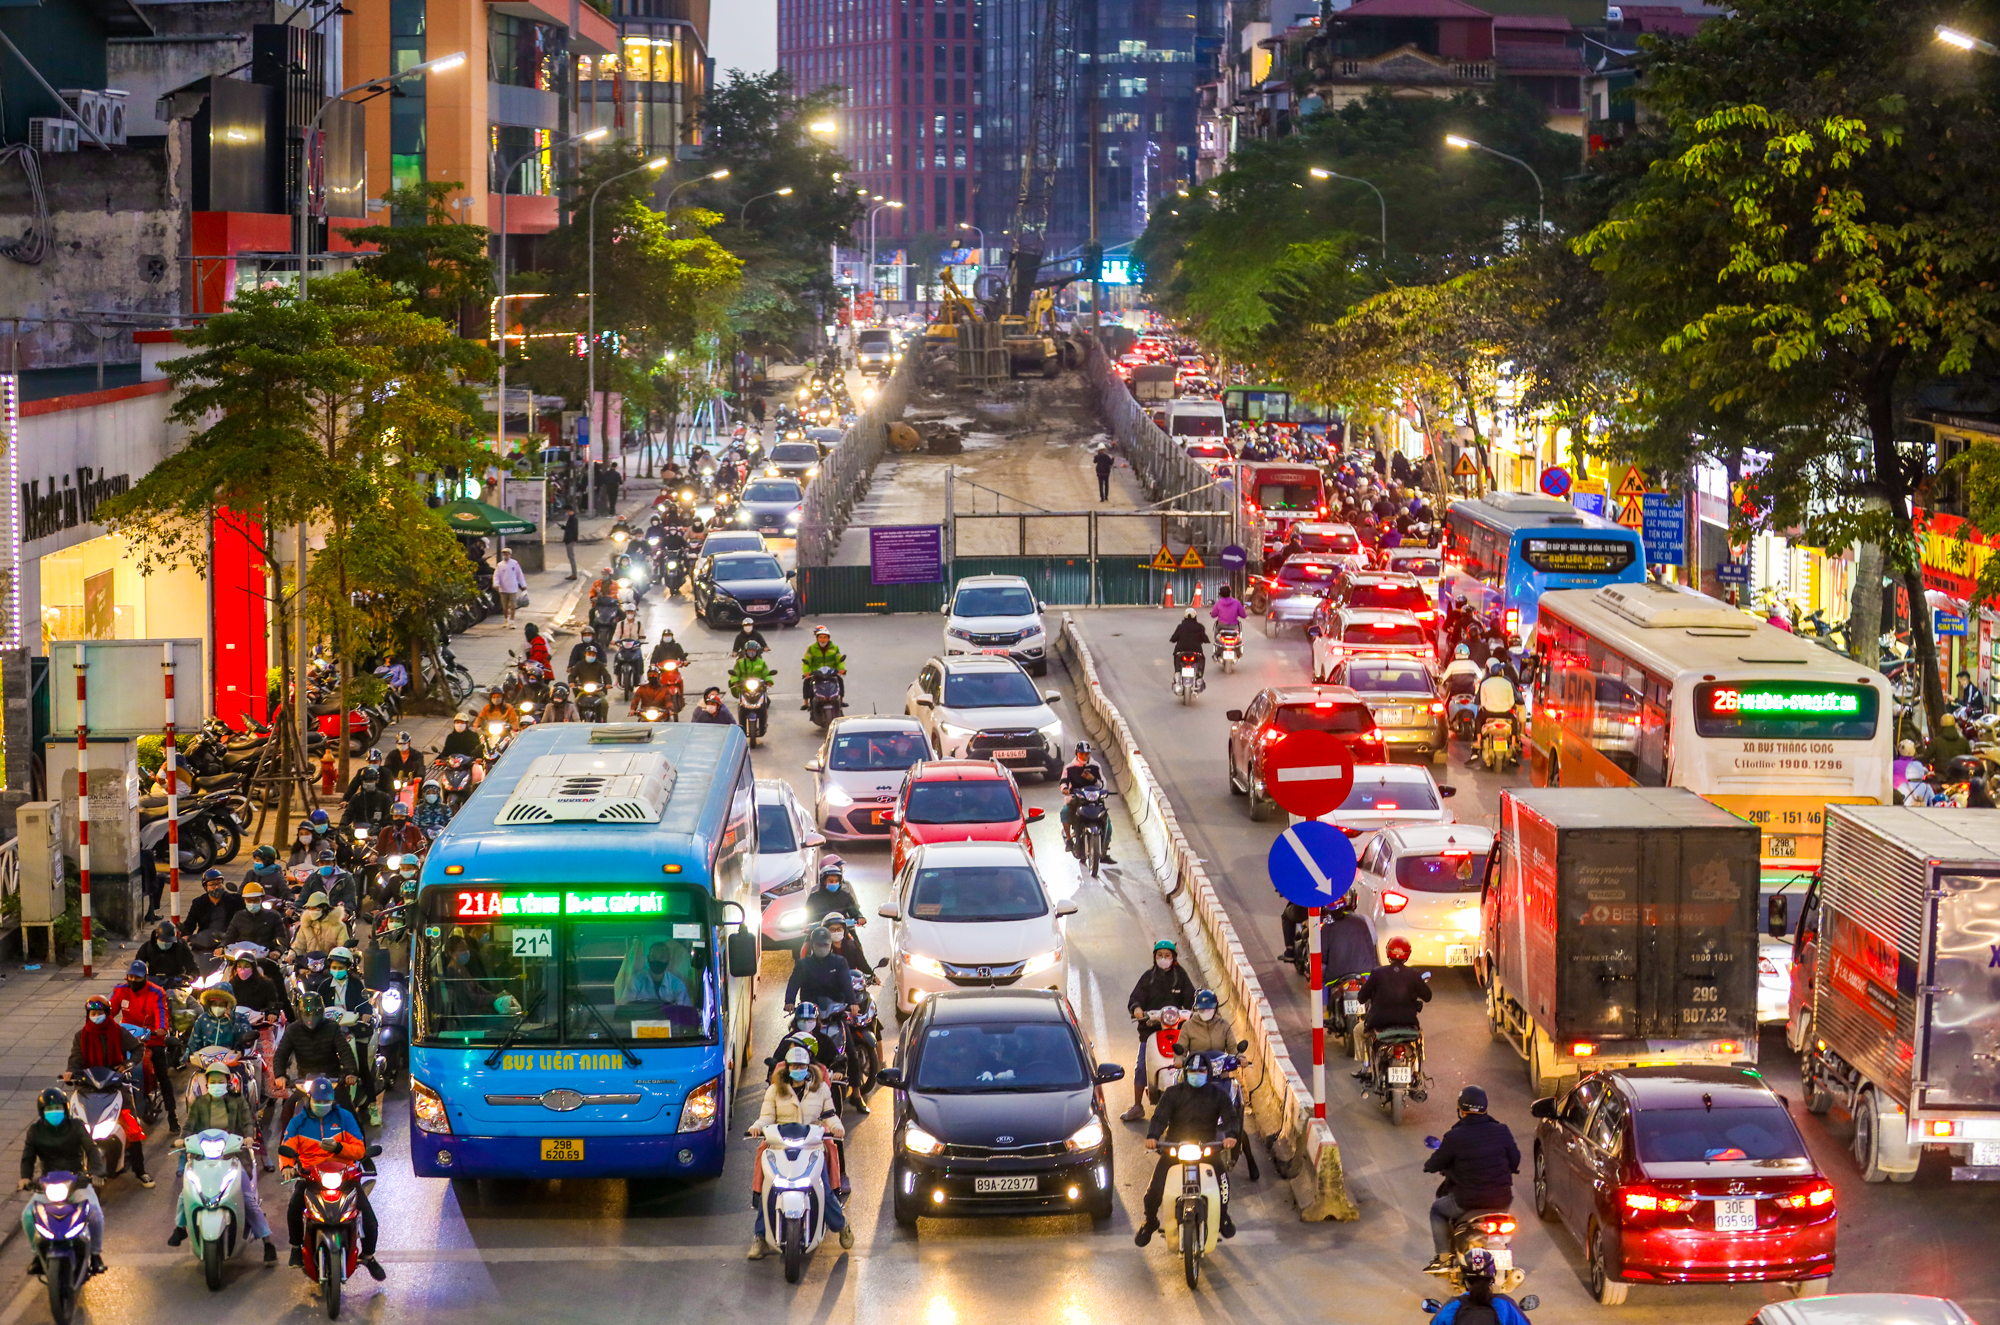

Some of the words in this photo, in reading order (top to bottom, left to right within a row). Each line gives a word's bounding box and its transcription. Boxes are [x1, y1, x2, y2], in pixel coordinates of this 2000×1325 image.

[1658, 509, 1667, 518] THI
[1549, 554, 1565, 563] BUS
[1938, 623, 1951, 631] SIM
[1714, 690, 1738, 710] 26
[1743, 742, 1755, 753] XN
[1757, 742, 1773, 753] BUS
[1810, 743, 1834, 754] LONG
[1742, 759, 1776, 769] Hotline
[1749, 810, 1771, 823] 29B
[1775, 838, 1790, 847] 29B
[1578, 876, 1600, 885] With
[1602, 877, 1620, 886] You
[458, 892, 502, 915] 21A
[1612, 908, 1653, 921] BEST
[1693, 986, 1718, 1002] 29C
[1683, 1007, 1727, 1023] 807.32
[503, 1054, 534, 1070] BUS
[539, 1051, 574, 1070] LIÊN
[580, 1054, 623, 1070] NINH
[553, 1141, 572, 1149] 29B
[546, 1151, 580, 1160] 620.69
[1725, 1201, 1745, 1214] 30E
